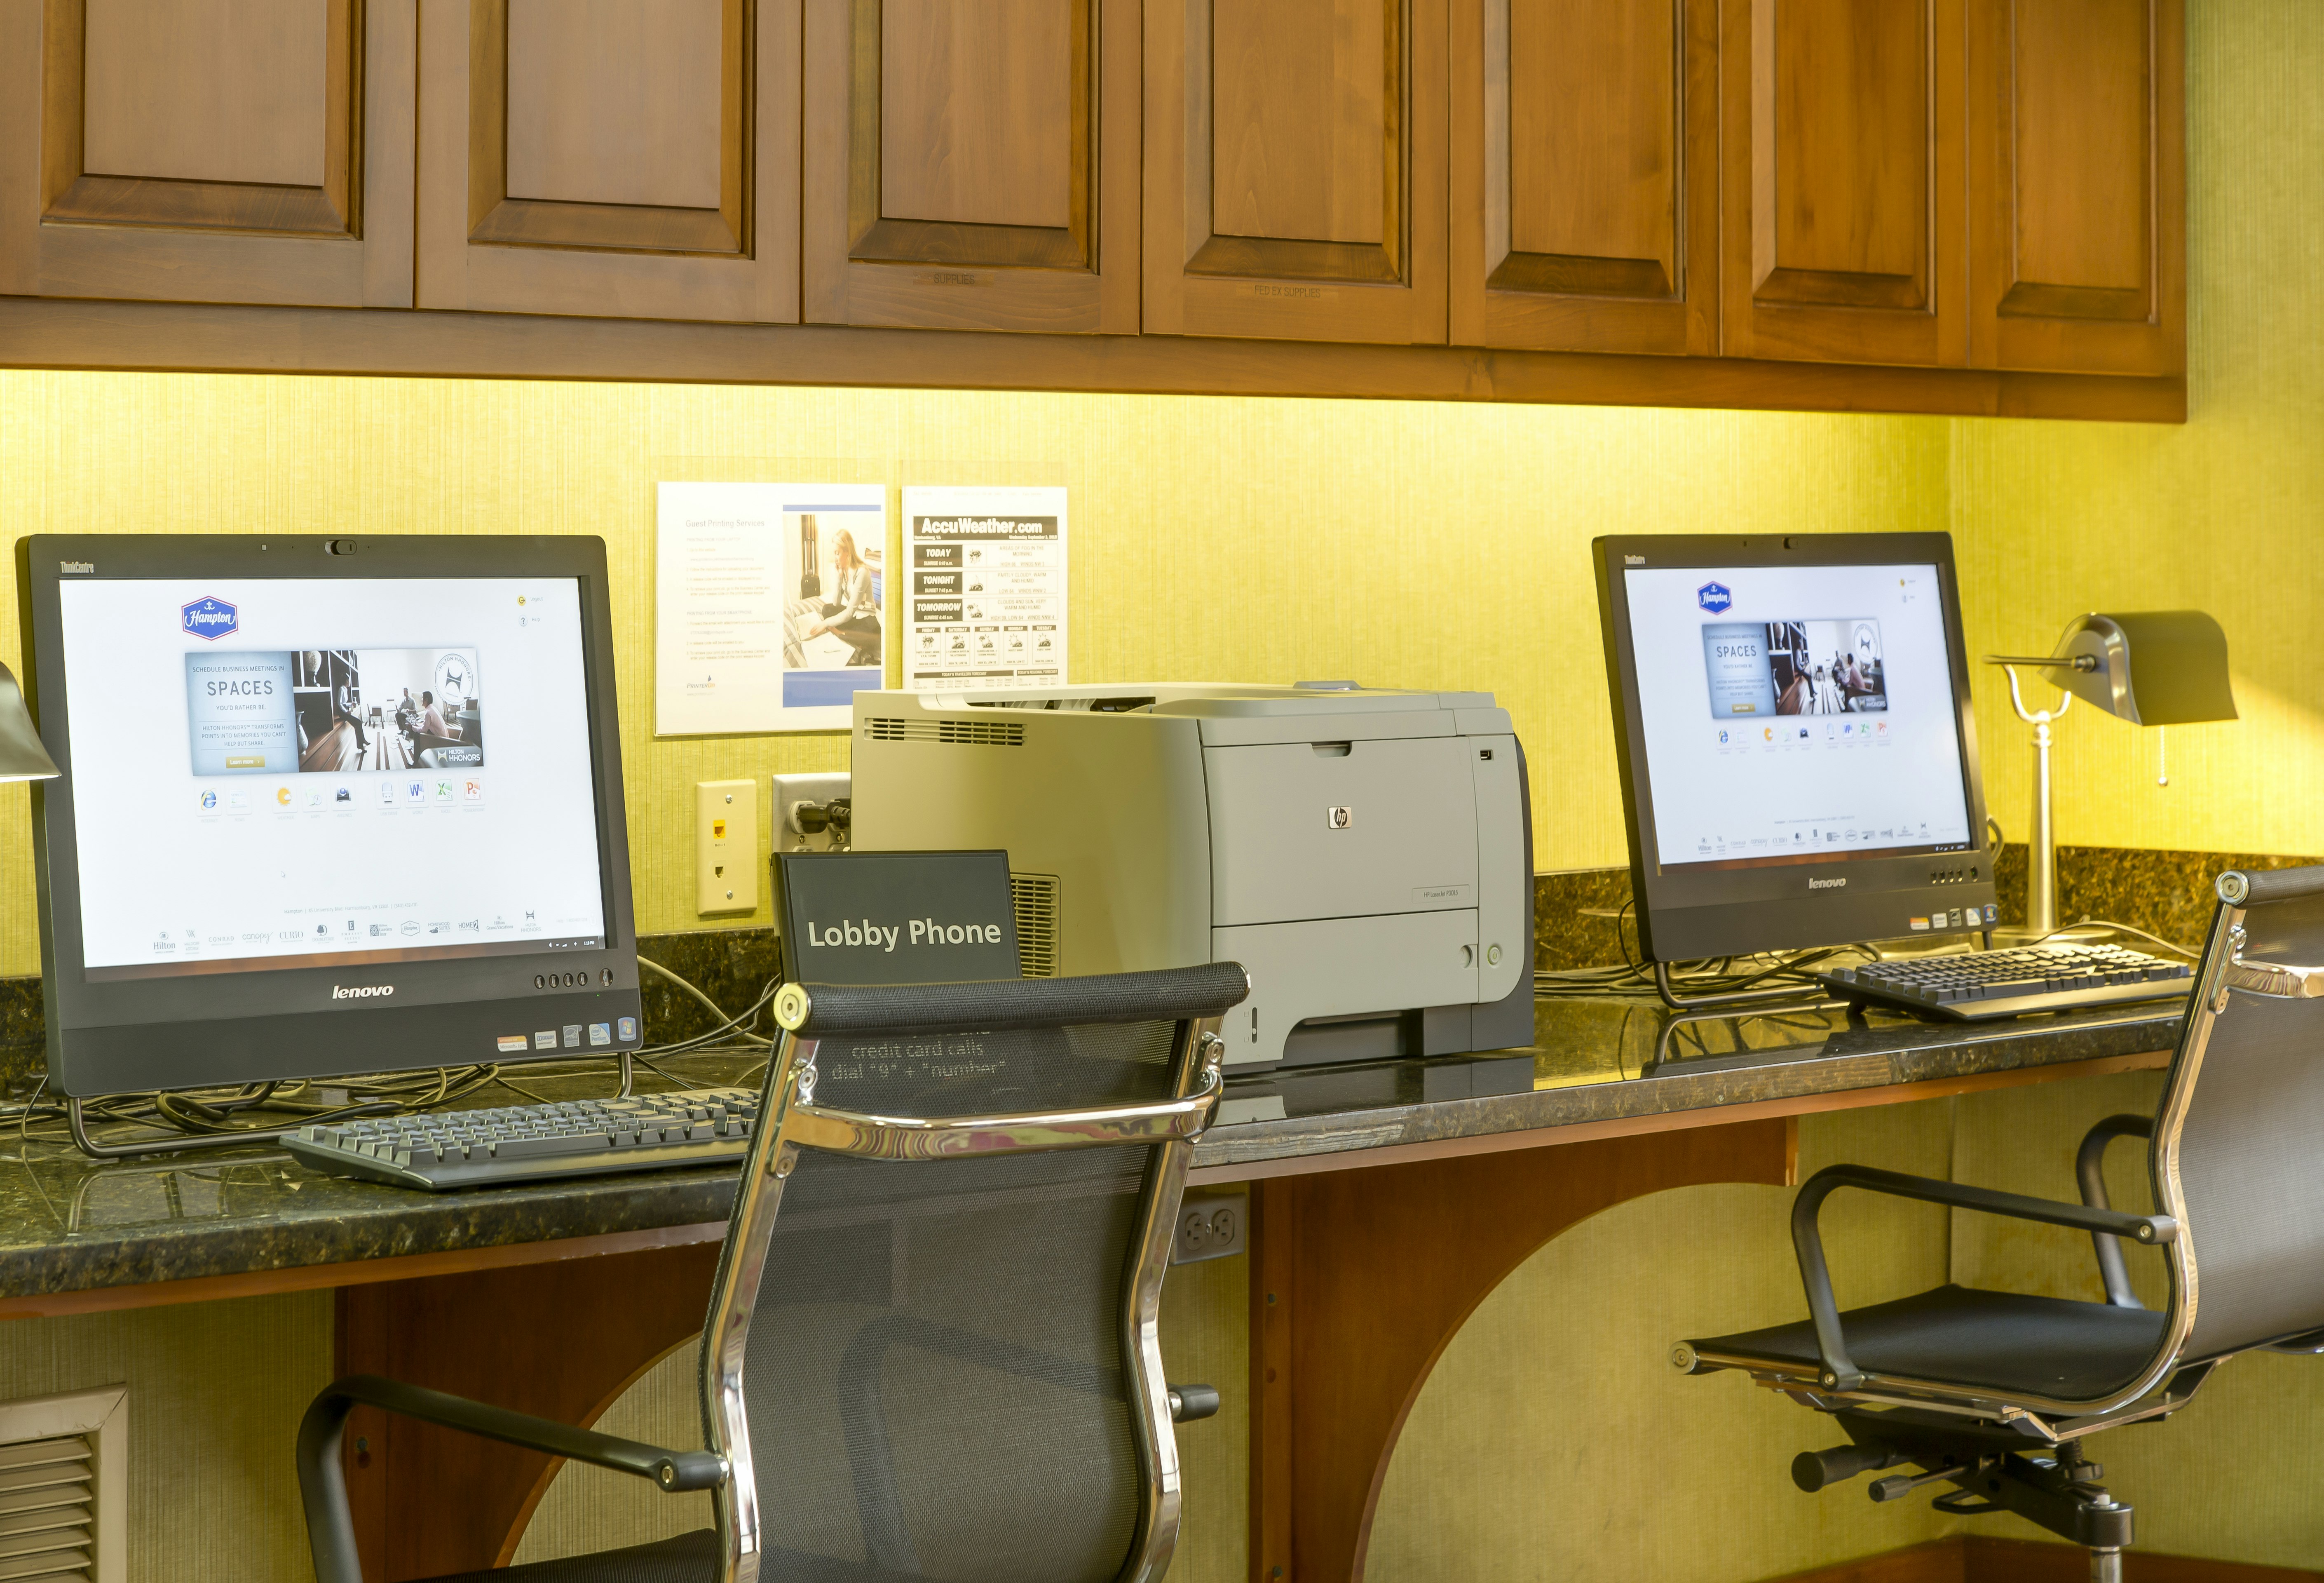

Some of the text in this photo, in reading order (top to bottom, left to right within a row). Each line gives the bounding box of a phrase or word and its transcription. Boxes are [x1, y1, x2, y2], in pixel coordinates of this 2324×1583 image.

[934, 273, 975, 285] SUPPLIES
[1255, 285, 1320, 298] FED EX SUPPLIES
[708, 519, 734, 529] Printing
[736, 519, 765, 527] Services
[921, 517, 1043, 534] AccuWeather.com
[926, 548, 952, 557] TODAY
[60, 561, 94, 573] ThinkCentre
[923, 575, 955, 585] TONIGHT
[1700, 591, 1731, 605] Hampton
[917, 603, 961, 612] TOMORROW
[185, 610, 235, 627] Hampton
[1717, 645, 1757, 658] SPACES
[439, 656, 471, 679] HILTON HHONORS
[207, 680, 273, 696] SPACES
[449, 754, 481, 762] HHONORS
[1335, 807, 1347, 828] hp
[1808, 877, 1847, 890] lenovo
[242, 932, 273, 944] canopy
[279, 930, 303, 939] CURIO
[808, 918, 1001, 953] Lobby Phone
[153, 942, 176, 950] Hilton
[332, 985, 394, 1000] lenovo
[852, 1042, 902, 1058] credit
[906, 1040, 942, 1057] card
[832, 1063, 863, 1079] dial
